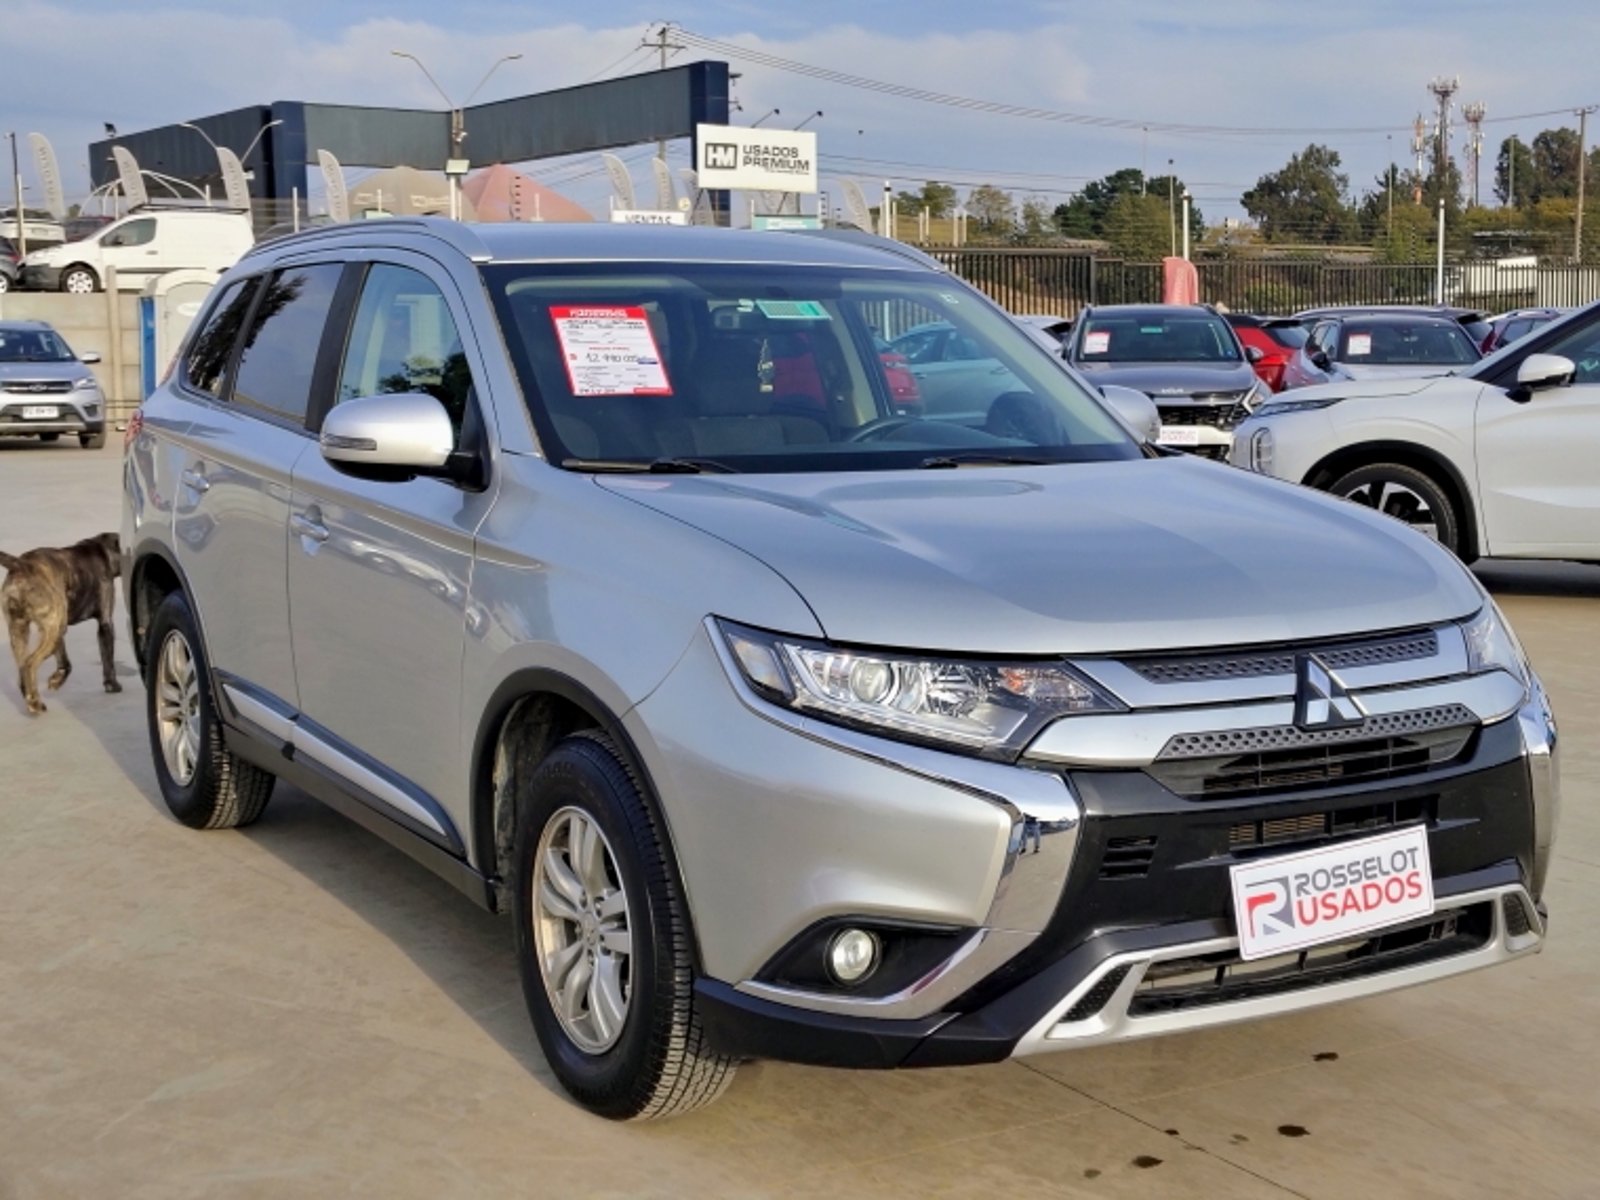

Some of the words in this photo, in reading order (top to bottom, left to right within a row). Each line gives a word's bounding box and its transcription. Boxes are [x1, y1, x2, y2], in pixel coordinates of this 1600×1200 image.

[705, 143, 738, 169] HM
[742, 144, 799, 158] USADOS
[742, 157, 810, 171] PREMIUM
[624, 213, 672, 225] VENTAS
[1294, 846, 1419, 897] ROSSELOT
[1296, 872, 1423, 925] USADOS
